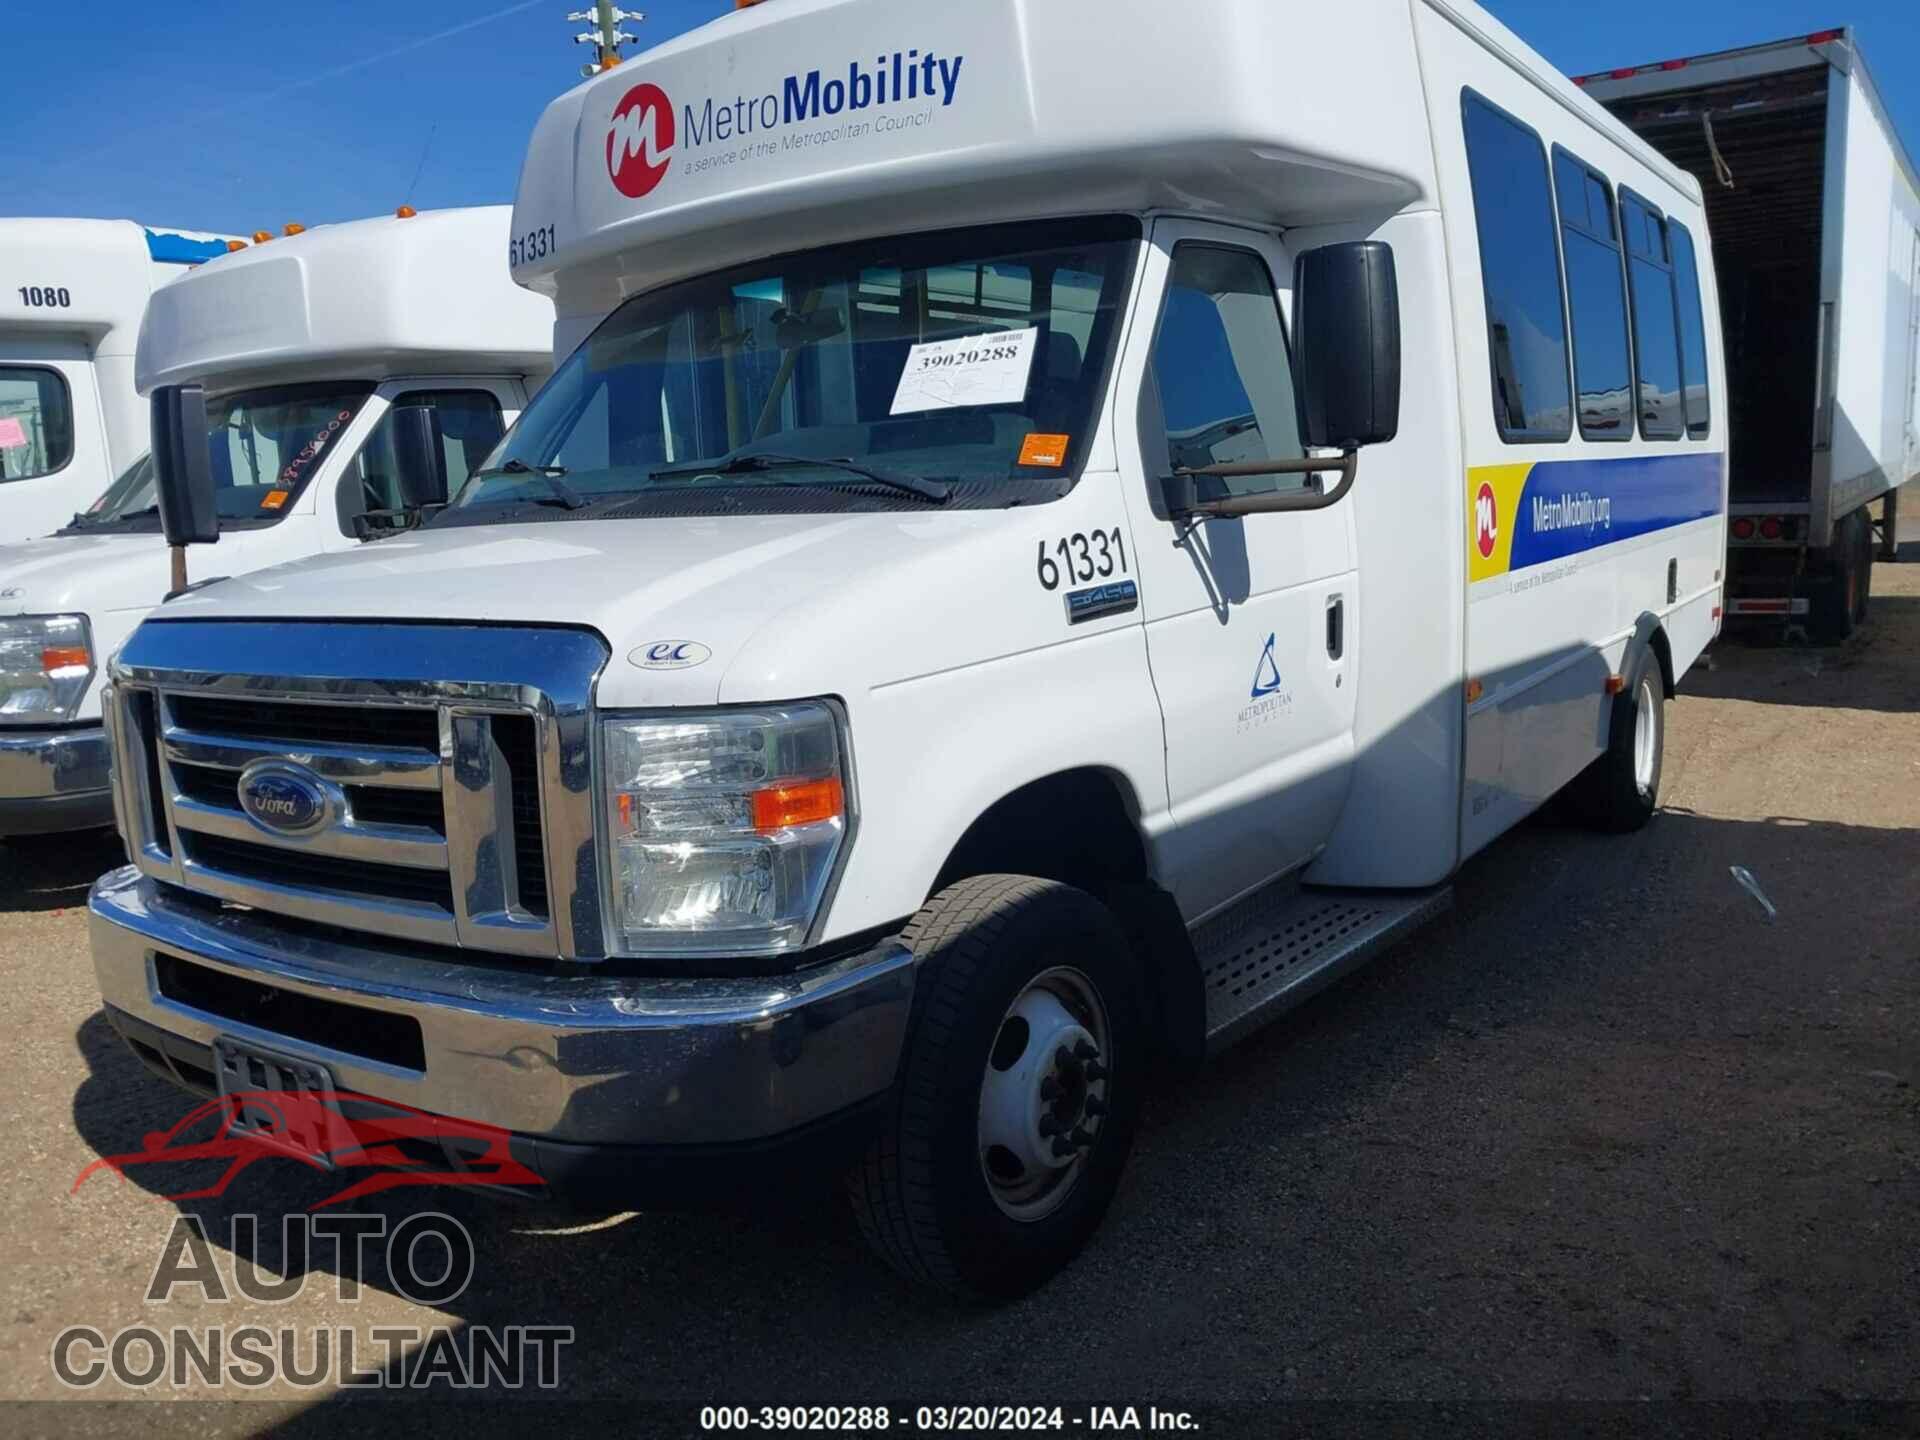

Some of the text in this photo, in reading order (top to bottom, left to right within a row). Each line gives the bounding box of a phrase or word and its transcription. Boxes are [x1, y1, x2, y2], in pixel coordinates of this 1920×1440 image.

[684, 50, 963, 149] MetroMobility
[684, 109, 933, 176] a service of the Metropolitan Council
[511, 223, 556, 268] 61331
[18, 286, 71, 307] 1080
[916, 344, 1018, 372] 39020288
[1533, 491, 1610, 533] MetroMobility.org
[1037, 526, 1128, 591] 61331
[254, 783, 297, 817] Ford
